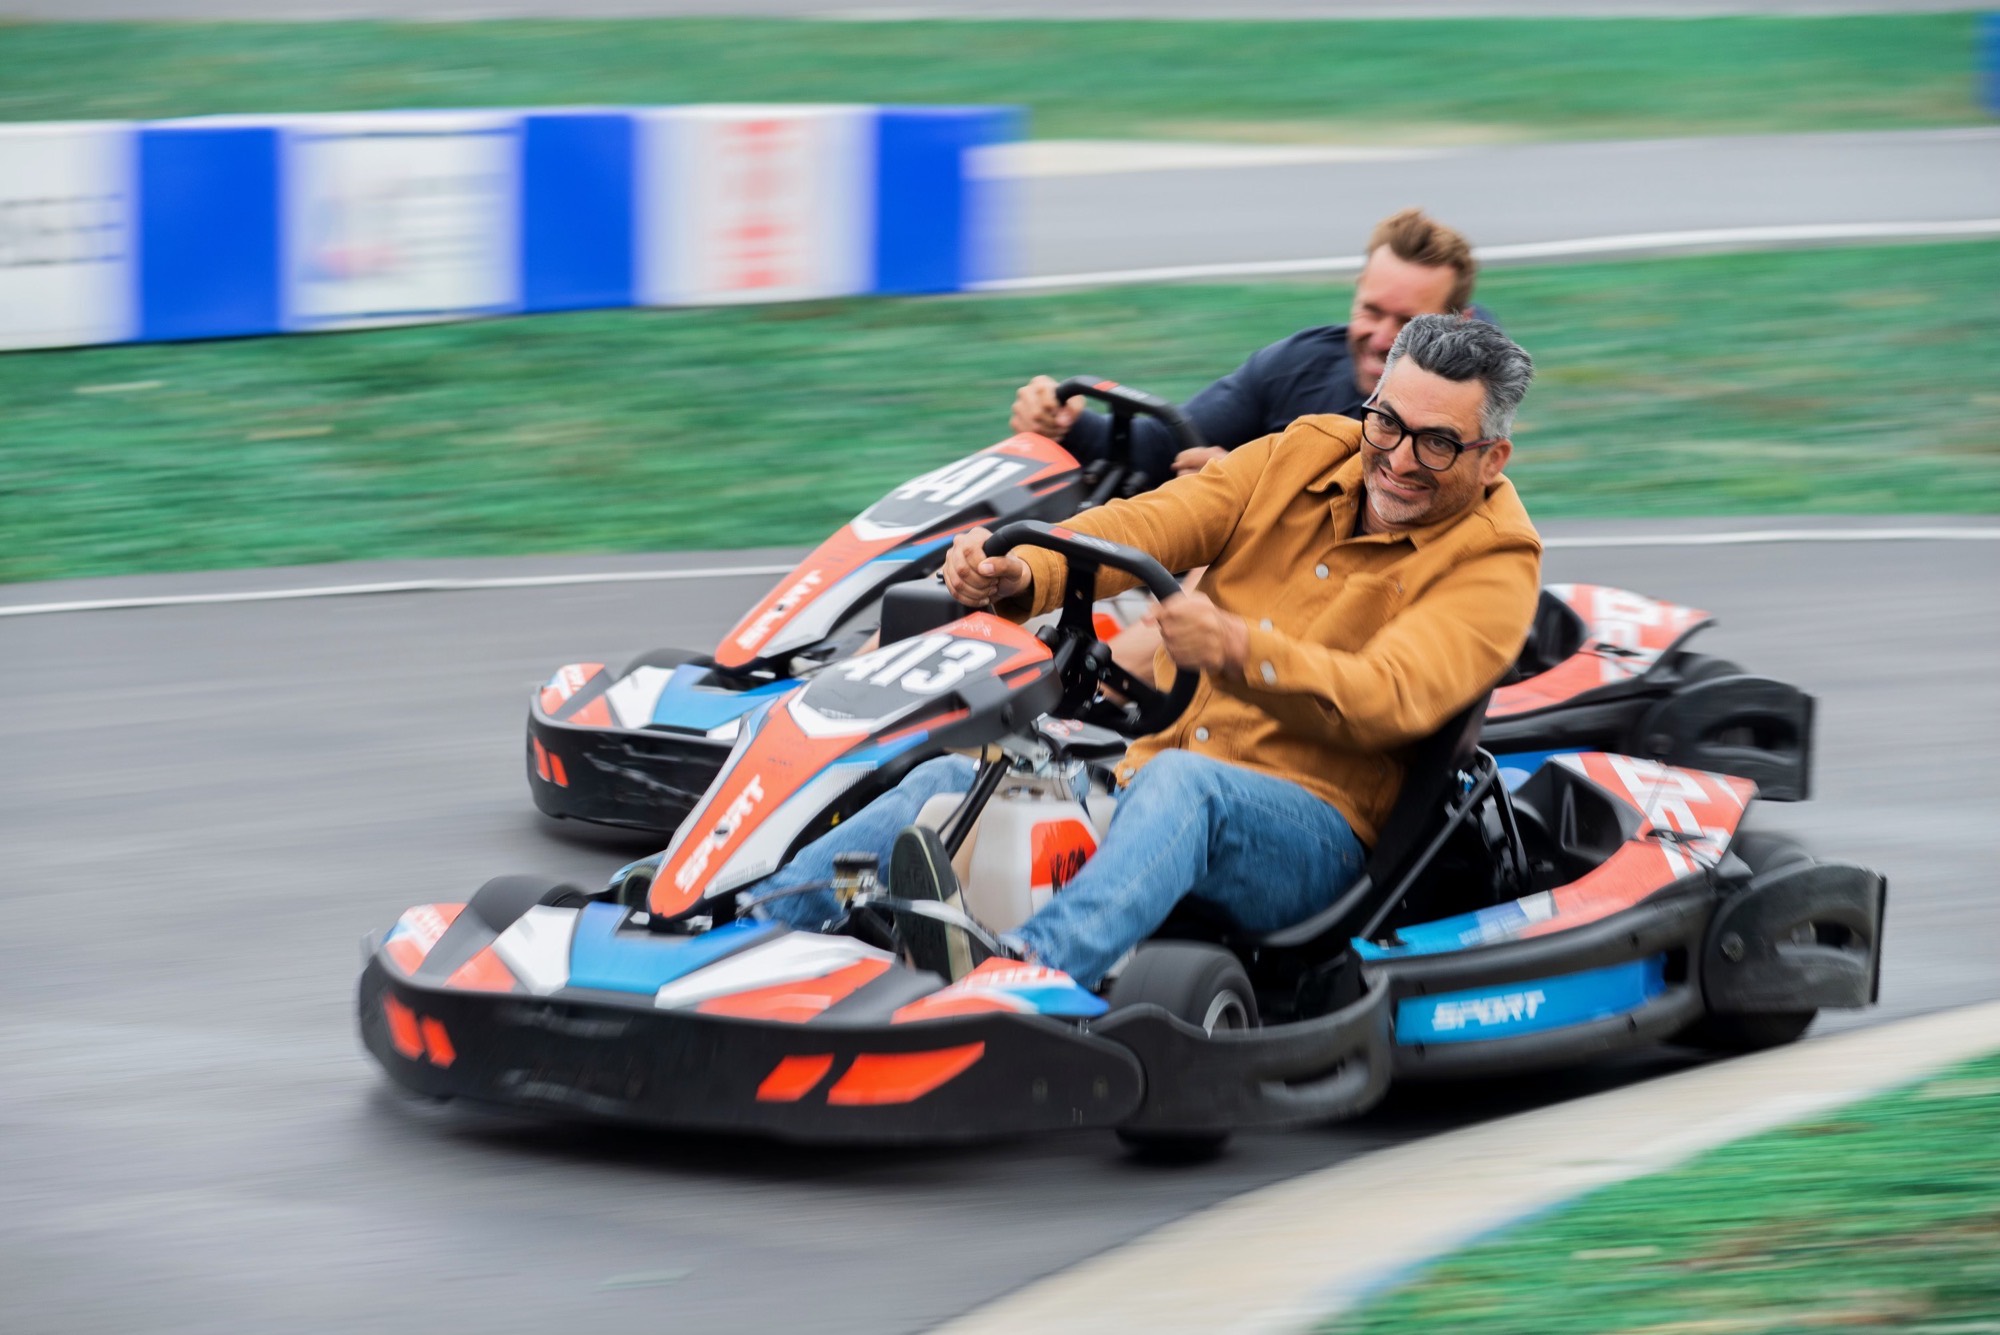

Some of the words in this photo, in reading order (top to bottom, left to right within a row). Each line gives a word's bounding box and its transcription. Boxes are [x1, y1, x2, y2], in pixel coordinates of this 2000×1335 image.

[894, 455, 1027, 507] 441
[736, 569, 823, 651] SPORT
[838, 632, 997, 696] 413
[674, 773, 765, 895] SPORT
[1431, 989, 1546, 1031] SPORT
